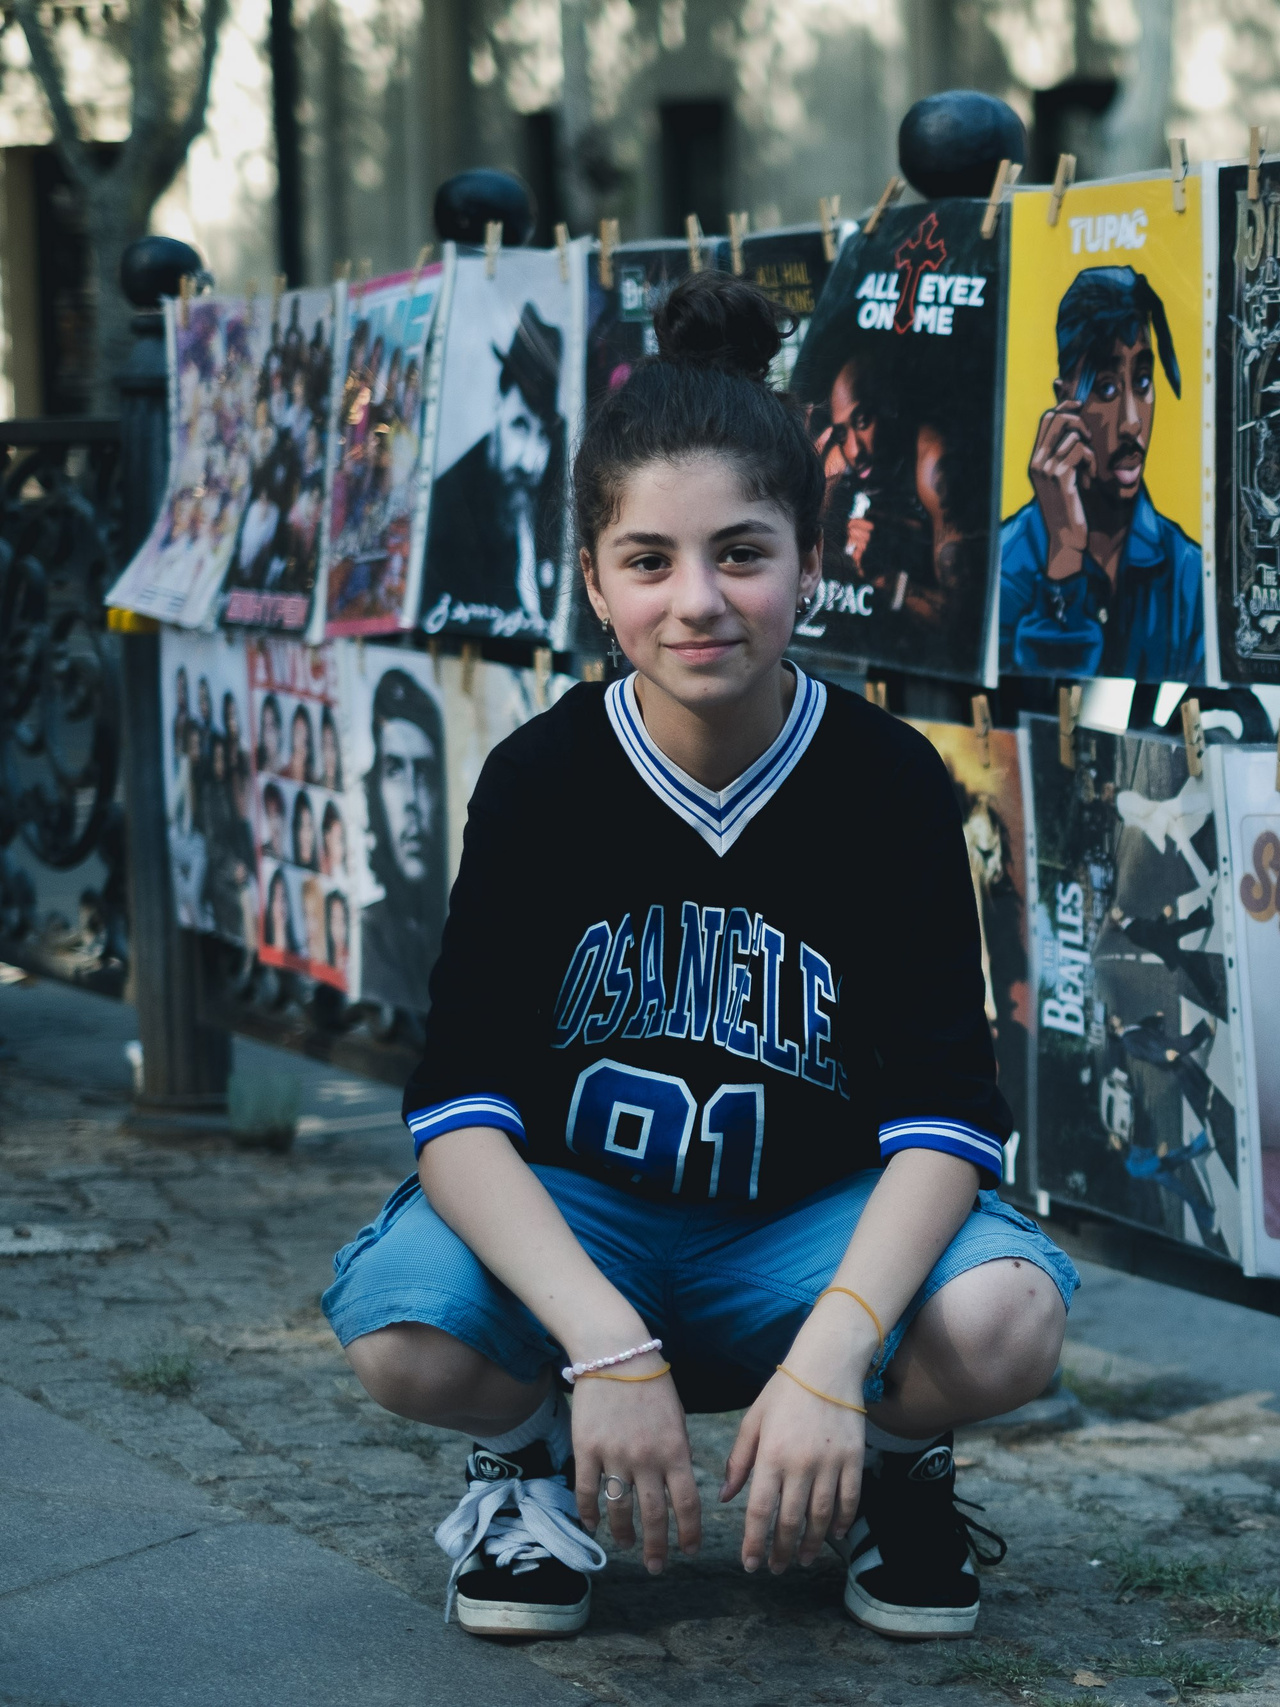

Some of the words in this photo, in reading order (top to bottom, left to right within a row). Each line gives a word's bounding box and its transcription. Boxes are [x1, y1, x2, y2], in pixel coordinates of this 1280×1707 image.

[1068, 210, 1149, 254] TUPAC
[855, 273, 899, 301] ALL
[917, 275, 986, 307] EYEZ
[857, 303, 896, 331] ON
[912, 306, 954, 335] ME
[1257, 563, 1277, 586] THE
[1042, 881, 1089, 1036] BEATLES
[621, 901, 850, 1100] ANGELE
